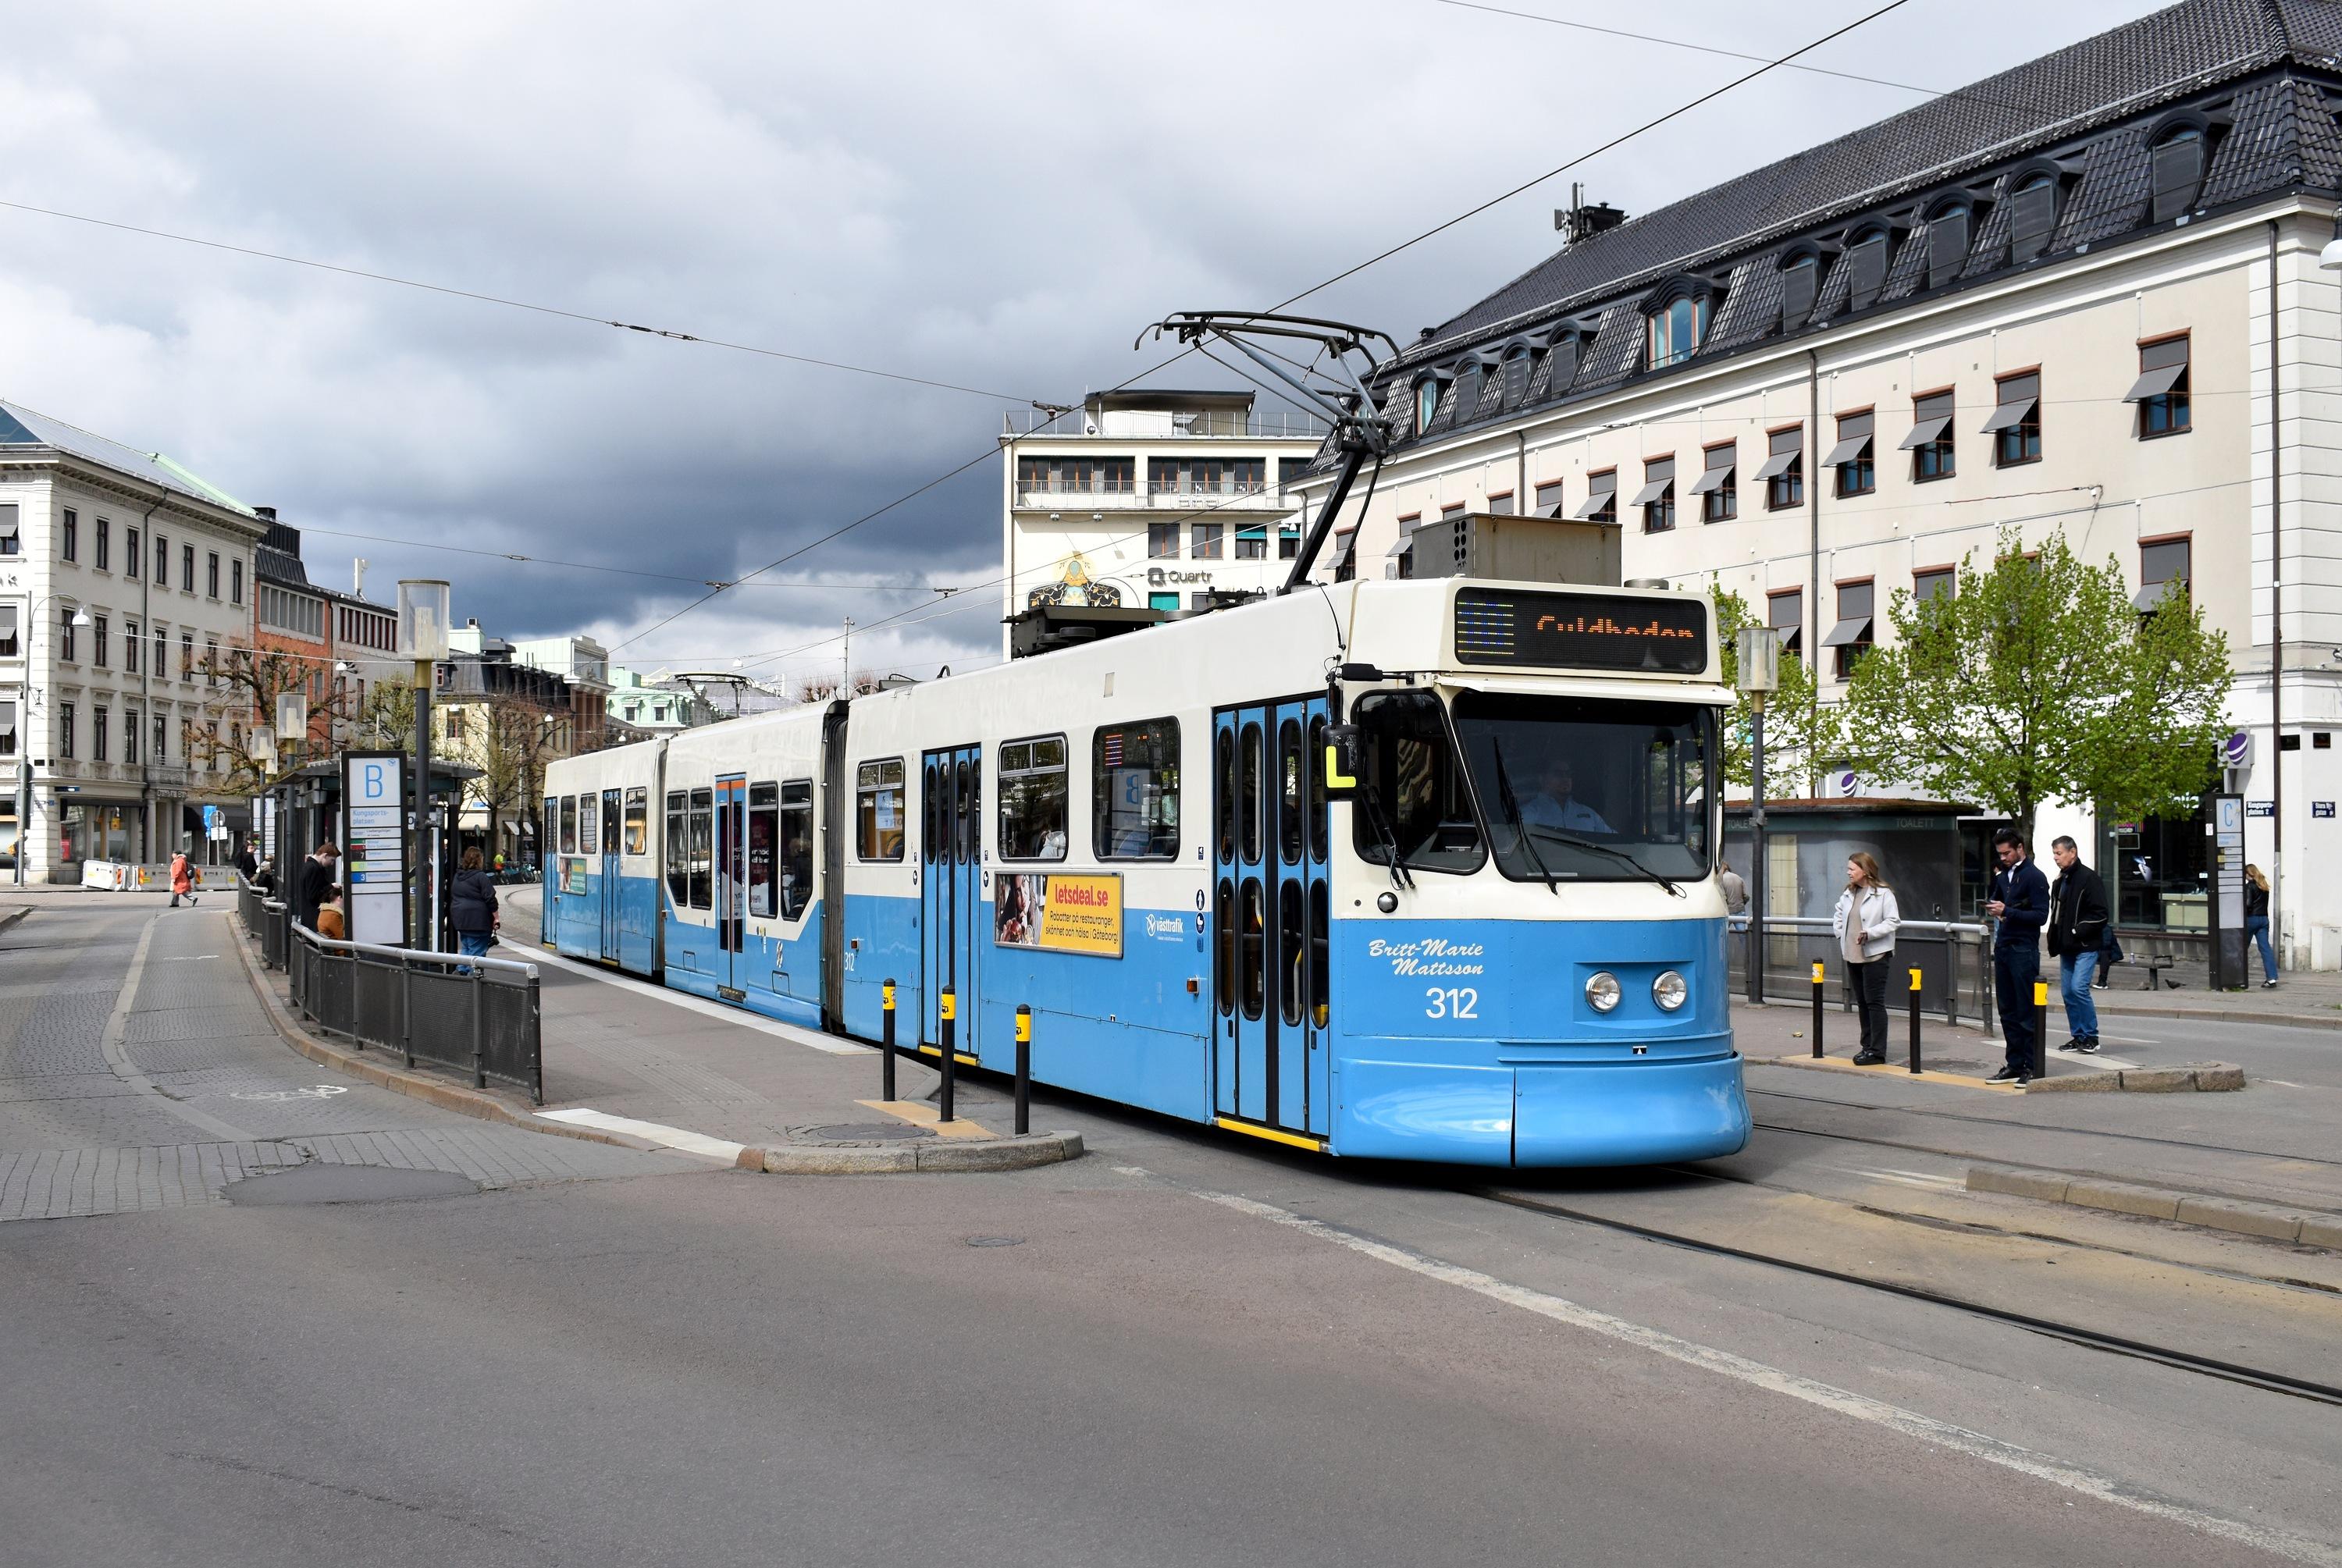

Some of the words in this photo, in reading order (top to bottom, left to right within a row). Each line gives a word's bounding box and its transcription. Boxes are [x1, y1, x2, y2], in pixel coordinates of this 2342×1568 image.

[1169, 571, 1212, 584] Quartr
[365, 765, 383, 798] B
[1726, 819, 1749, 829] TOALE
[1895, 818, 1934, 829] TOALETT
[2224, 803, 2233, 827] C
[1055, 884, 1109, 907] letsdeal.se
[1050, 910, 1072, 922] Rabatter
[1072, 912, 1079, 925] på
[1080, 915, 1114, 928] restauranger,
[1156, 917, 1183, 933] västtrafik
[1045, 924, 1065, 937] skönhet
[1066, 925, 1075, 937] och
[1075, 926, 1089, 939] hälsa
[1092, 928, 1119, 944] Göteborg!
[1369, 939, 1484, 957] Britt-Marie
[845, 952, 855, 972] 312
[1391, 958, 1484, 976] Mattsson
[1425, 987, 1478, 1019] 312
